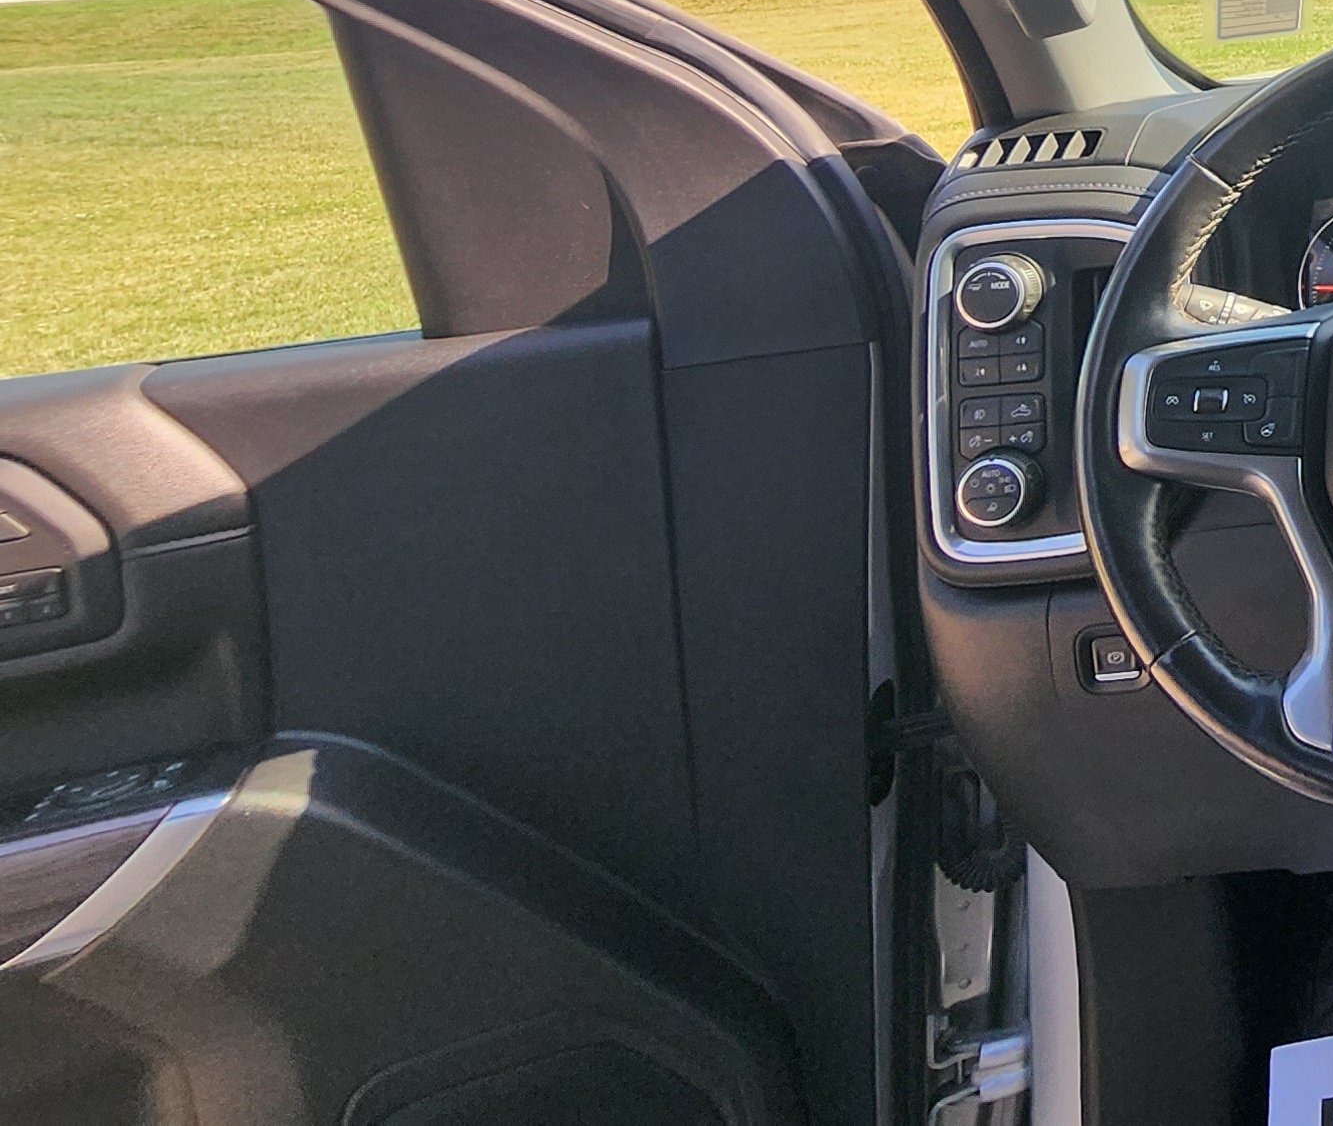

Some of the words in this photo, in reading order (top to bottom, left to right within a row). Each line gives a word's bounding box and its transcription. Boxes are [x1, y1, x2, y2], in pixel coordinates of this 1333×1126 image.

[990, 280, 1010, 290] MODE
[969, 340, 988, 349] AUTO
[1201, 432, 1213, 440] SET
[982, 469, 1000, 478] AUTO
